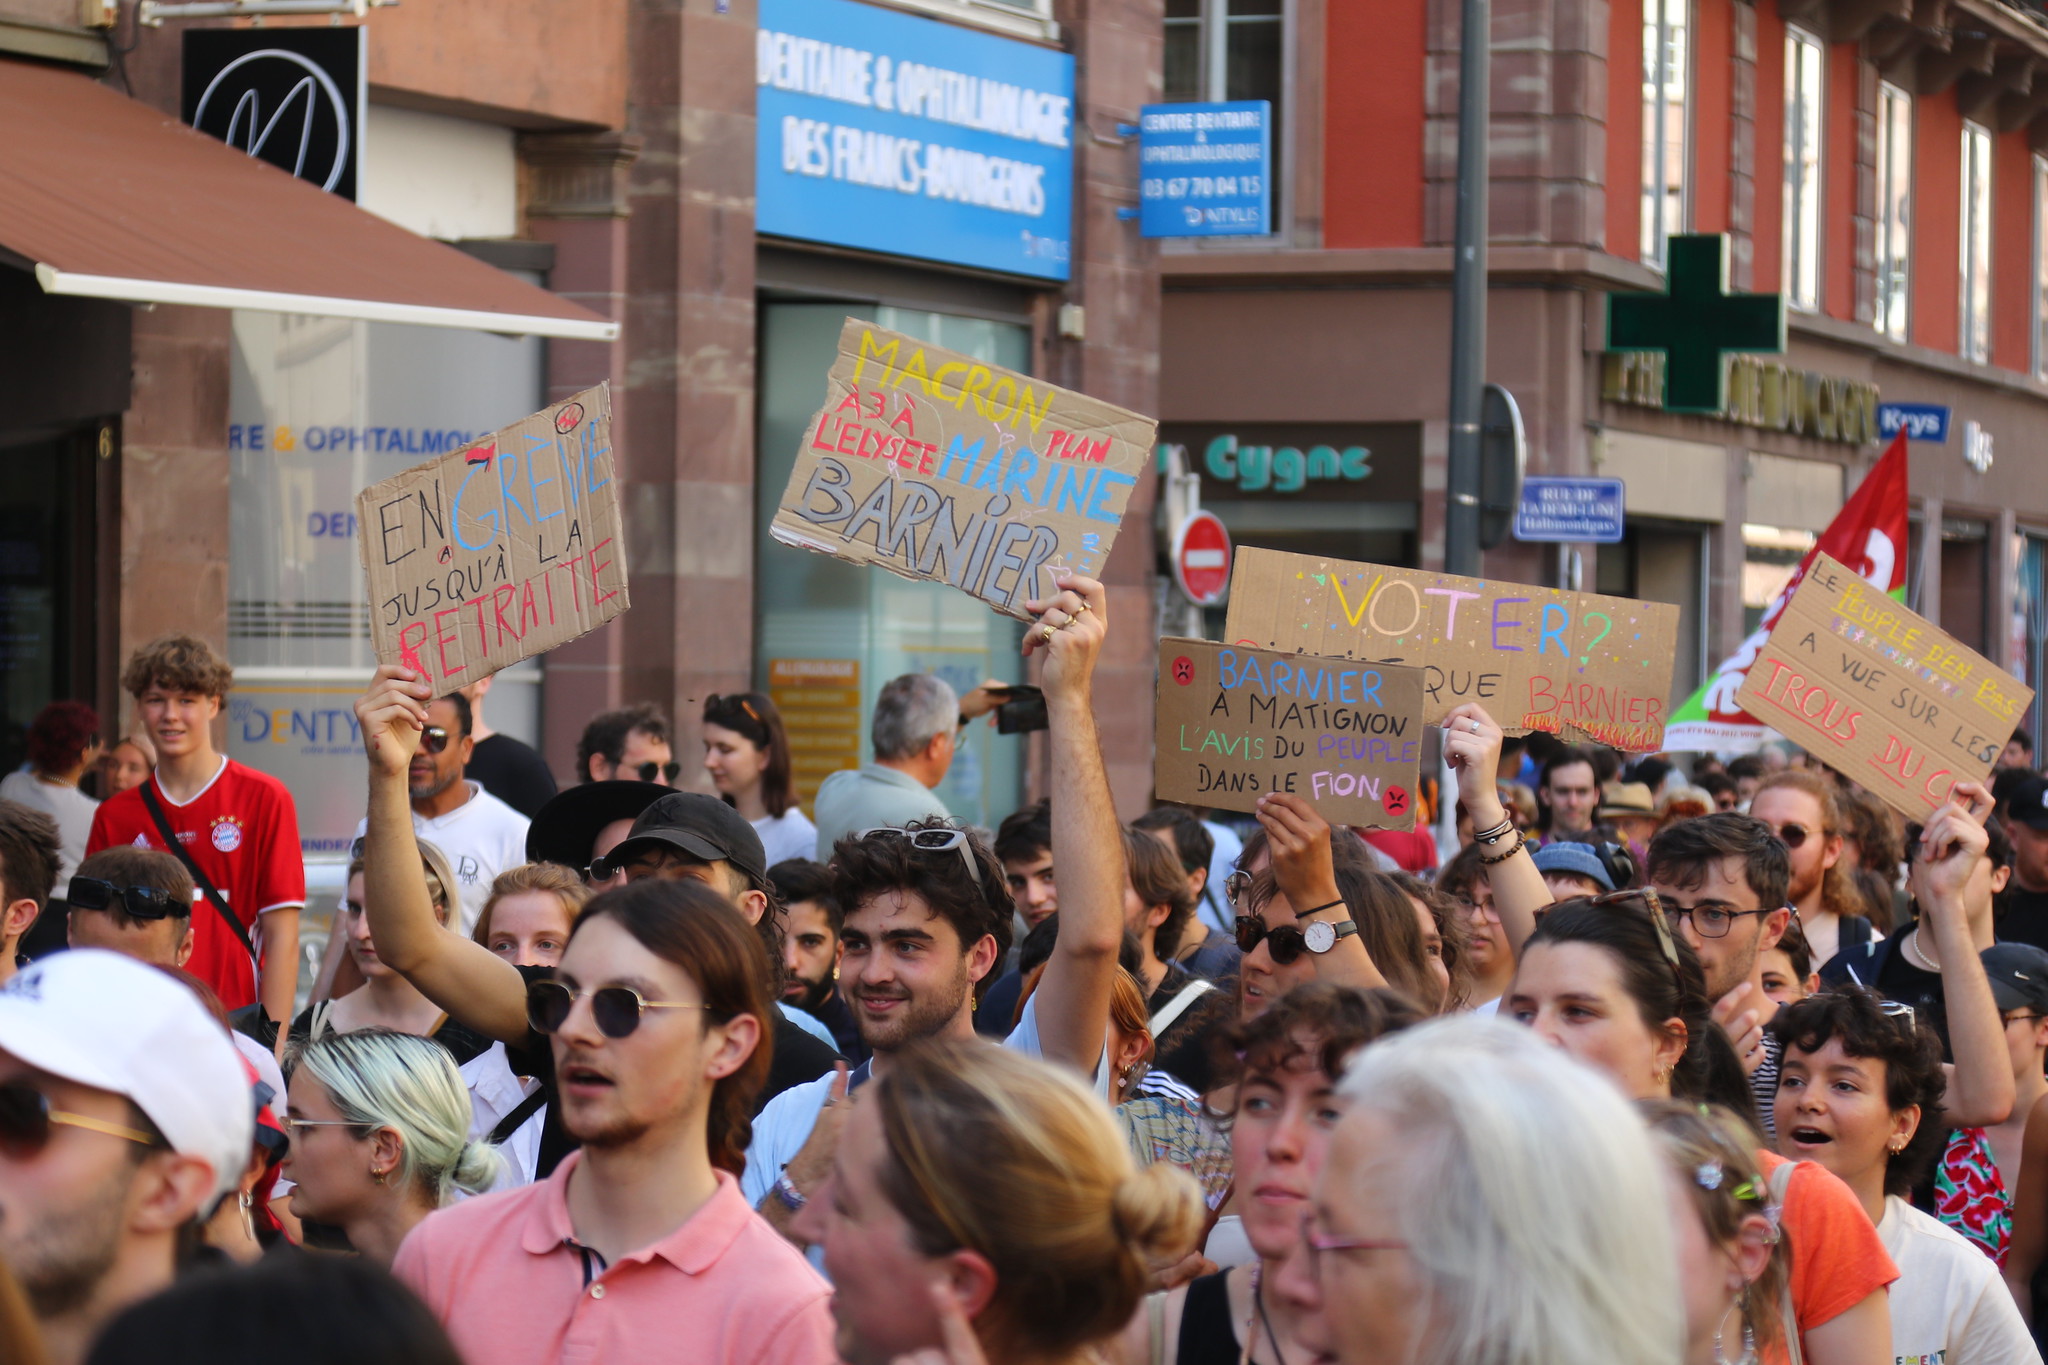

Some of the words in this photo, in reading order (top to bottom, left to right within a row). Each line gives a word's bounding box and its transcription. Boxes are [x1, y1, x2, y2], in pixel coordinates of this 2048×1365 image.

[757, 29, 872, 107] DENTAIRE
[874, 55, 893, 111] &
[782, 115, 829, 178] DES
[1142, 113, 1193, 131] CENTRE
[1196, 111, 1260, 129] DENTAIRE
[1142, 143, 1260, 162] OPHTALMOLOGIQUE
[1144, 178, 1164, 198] 03
[1166, 178, 1189, 198] 67
[1191, 177, 1213, 197] 70
[1215, 176, 1238, 196] 04
[1240, 175, 1261, 195] 15
[853, 329, 1055, 434] MACRON
[273, 425, 294, 451] &
[811, 413, 938, 476] L'ELYSEE
[379, 478, 447, 566] EN
[452, 414, 612, 550] GRÈVE
[936, 433, 1137, 524] MARINE
[1045, 430, 1113, 463] PLAN
[1541, 487, 1571, 501] RUE
[1576, 488, 1598, 501] DE
[793, 457, 1059, 612] BARNIER
[382, 543, 507, 626] JUSQU'À
[399, 537, 618, 683] RETRAITE
[1330, 572, 1612, 659] VOTER?
[1811, 560, 1839, 593] LE
[1836, 583, 1922, 651] PEUPLE
[1210, 682, 1230, 718] À
[1249, 693, 1408, 737] MATIGNON
[1218, 650, 1384, 708] BARNIER
[1528, 675, 1663, 724] BARNIER
[1799, 632, 1816, 654] A
[1841, 653, 1887, 692] VUE
[1891, 687, 1940, 729] SUR
[1951, 726, 2000, 764] LES
[1179, 724, 1265, 761] L'AVIS
[1273, 735, 1305, 759] DU
[1317, 734, 1418, 763] PEUPLE
[1764, 658, 1864, 741] TROUS
[1873, 735, 1926, 779] DU
[1197, 763, 1260, 793] DANS
[1272, 772, 1298, 793] LE
[1311, 770, 1382, 801] FION
